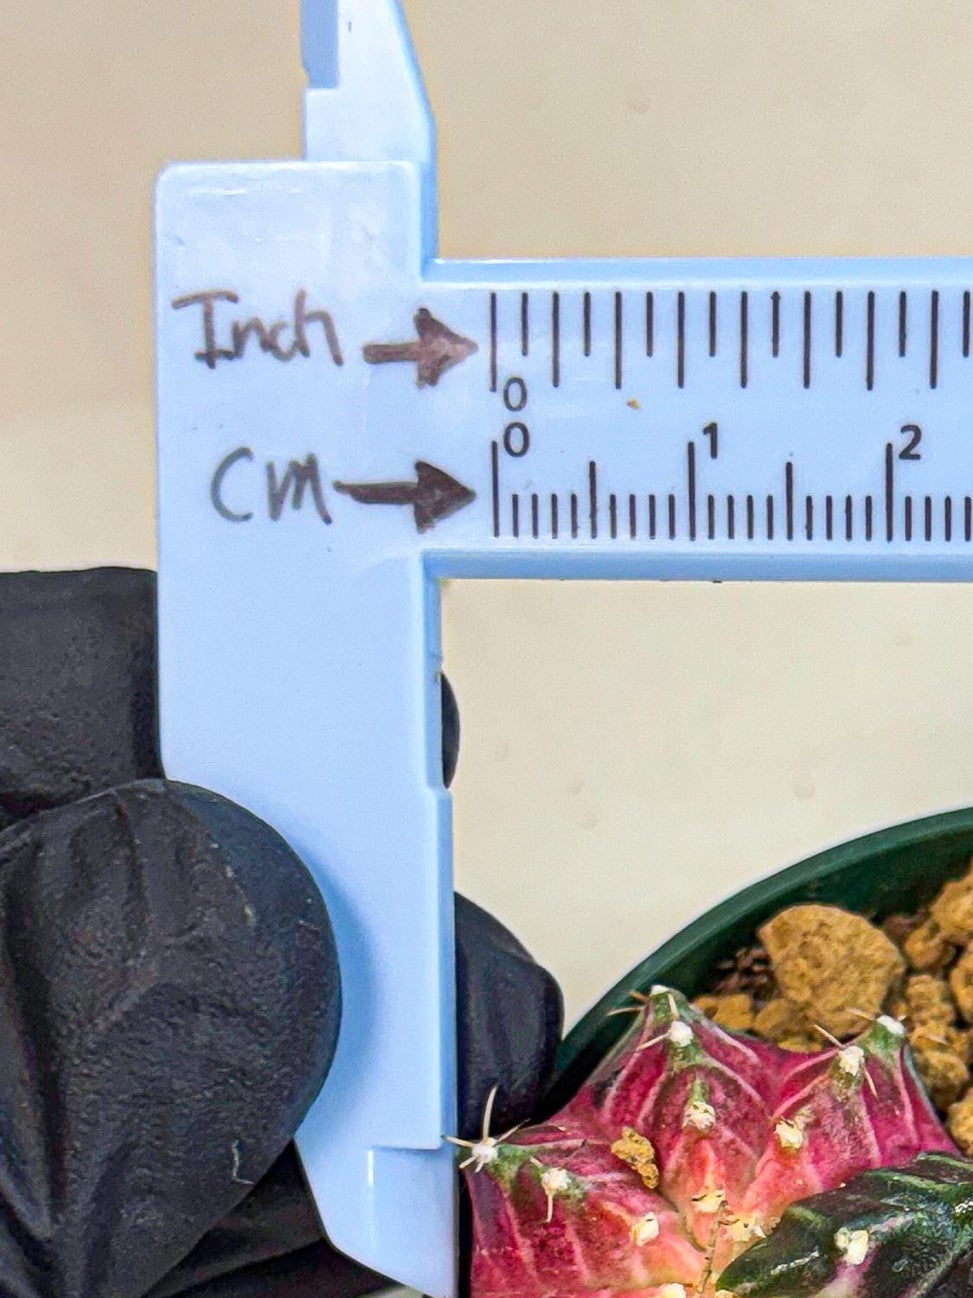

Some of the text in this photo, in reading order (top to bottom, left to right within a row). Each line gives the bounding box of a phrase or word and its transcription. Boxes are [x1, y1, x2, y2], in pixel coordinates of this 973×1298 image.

[172, 288, 344, 370] Inch
[503, 377, 528, 412] 0
[503, 422, 530, 458] 0
[702, 422, 718, 460] 1
[898, 424, 923, 461] 2
